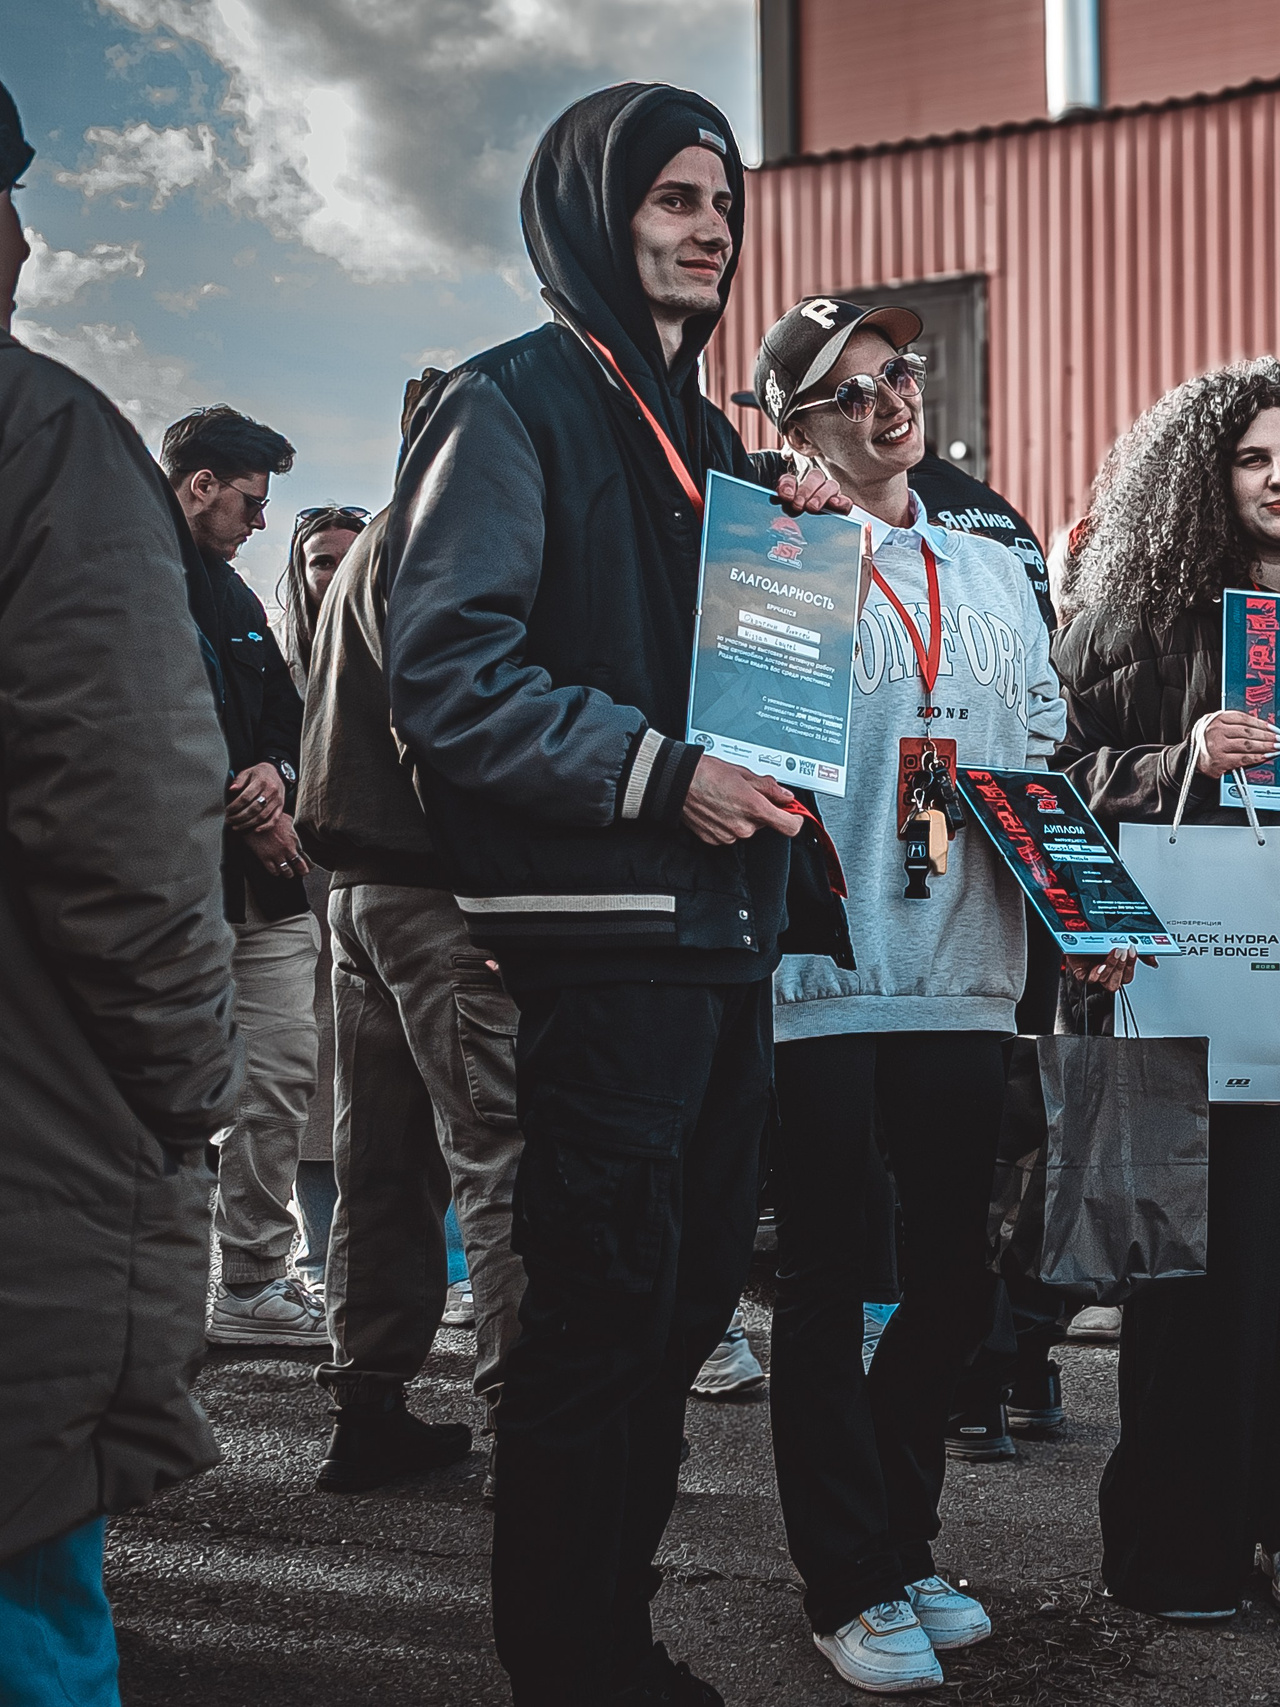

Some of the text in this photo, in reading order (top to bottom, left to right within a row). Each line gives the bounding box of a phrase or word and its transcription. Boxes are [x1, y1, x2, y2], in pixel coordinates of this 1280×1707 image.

[938, 508, 1016, 533] ЯрНива
[772, 543, 801, 559] JST
[729, 567, 835, 610] БЛАГОДАРНОСТЬ
[766, 603, 797, 617] ВРУЧАЕТСЯ
[853, 602, 1029, 730] OMFORT
[917, 706, 969, 720] ZONE
[799, 759, 817, 770] WOW
[799, 767, 815, 777] FEST
[1043, 824, 1085, 834] ДИПЛОМ
[1224, 934, 1279, 944] HYDRA
[1179, 946, 1270, 957] EAF BONCE
